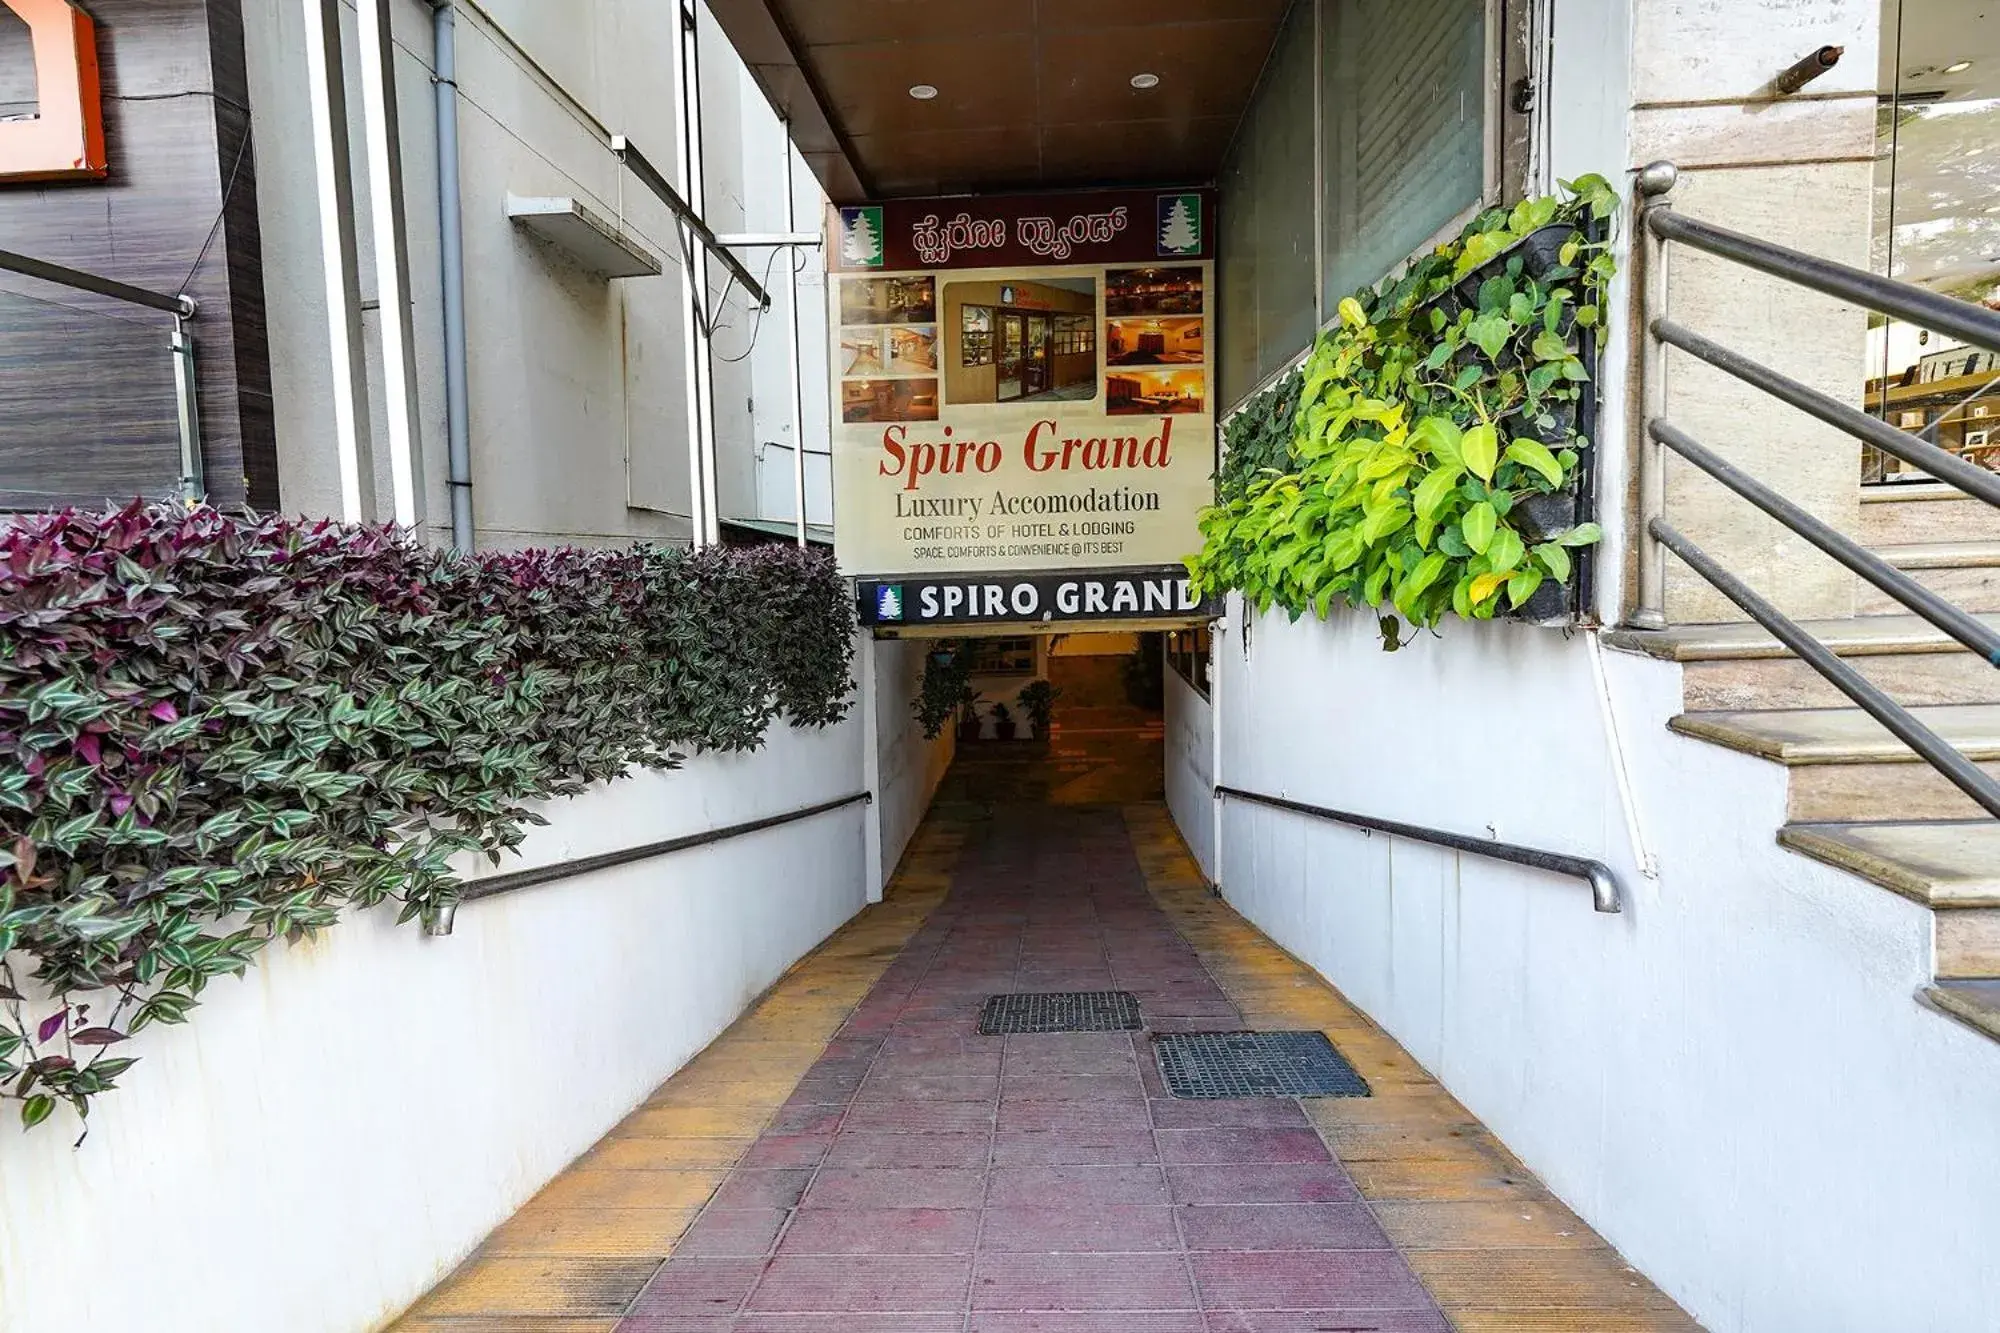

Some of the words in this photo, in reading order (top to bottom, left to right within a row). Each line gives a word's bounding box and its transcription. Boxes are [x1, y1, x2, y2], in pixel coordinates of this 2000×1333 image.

[879, 425, 1003, 490] Spiro
[1023, 417, 1173, 473] Grand
[896, 493, 984, 522] Luxury
[990, 487, 1160, 516] Accomodation
[903, 526, 981, 541] COMFORTS
[987, 524, 1005, 538] OF
[1012, 523, 1056, 538] HOTEL
[1058, 523, 1070, 537] &
[1073, 521, 1135, 537] LODGING
[947, 545, 998, 558] COMFORTS
[998, 544, 1007, 557] &
[1007, 543, 1070, 557] CONVENIENCE
[1071, 542, 1082, 557] @
[1100, 541, 1124, 554] BEST
[920, 582, 1039, 618] SPIRO
[1056, 578, 1202, 615] GRAND
